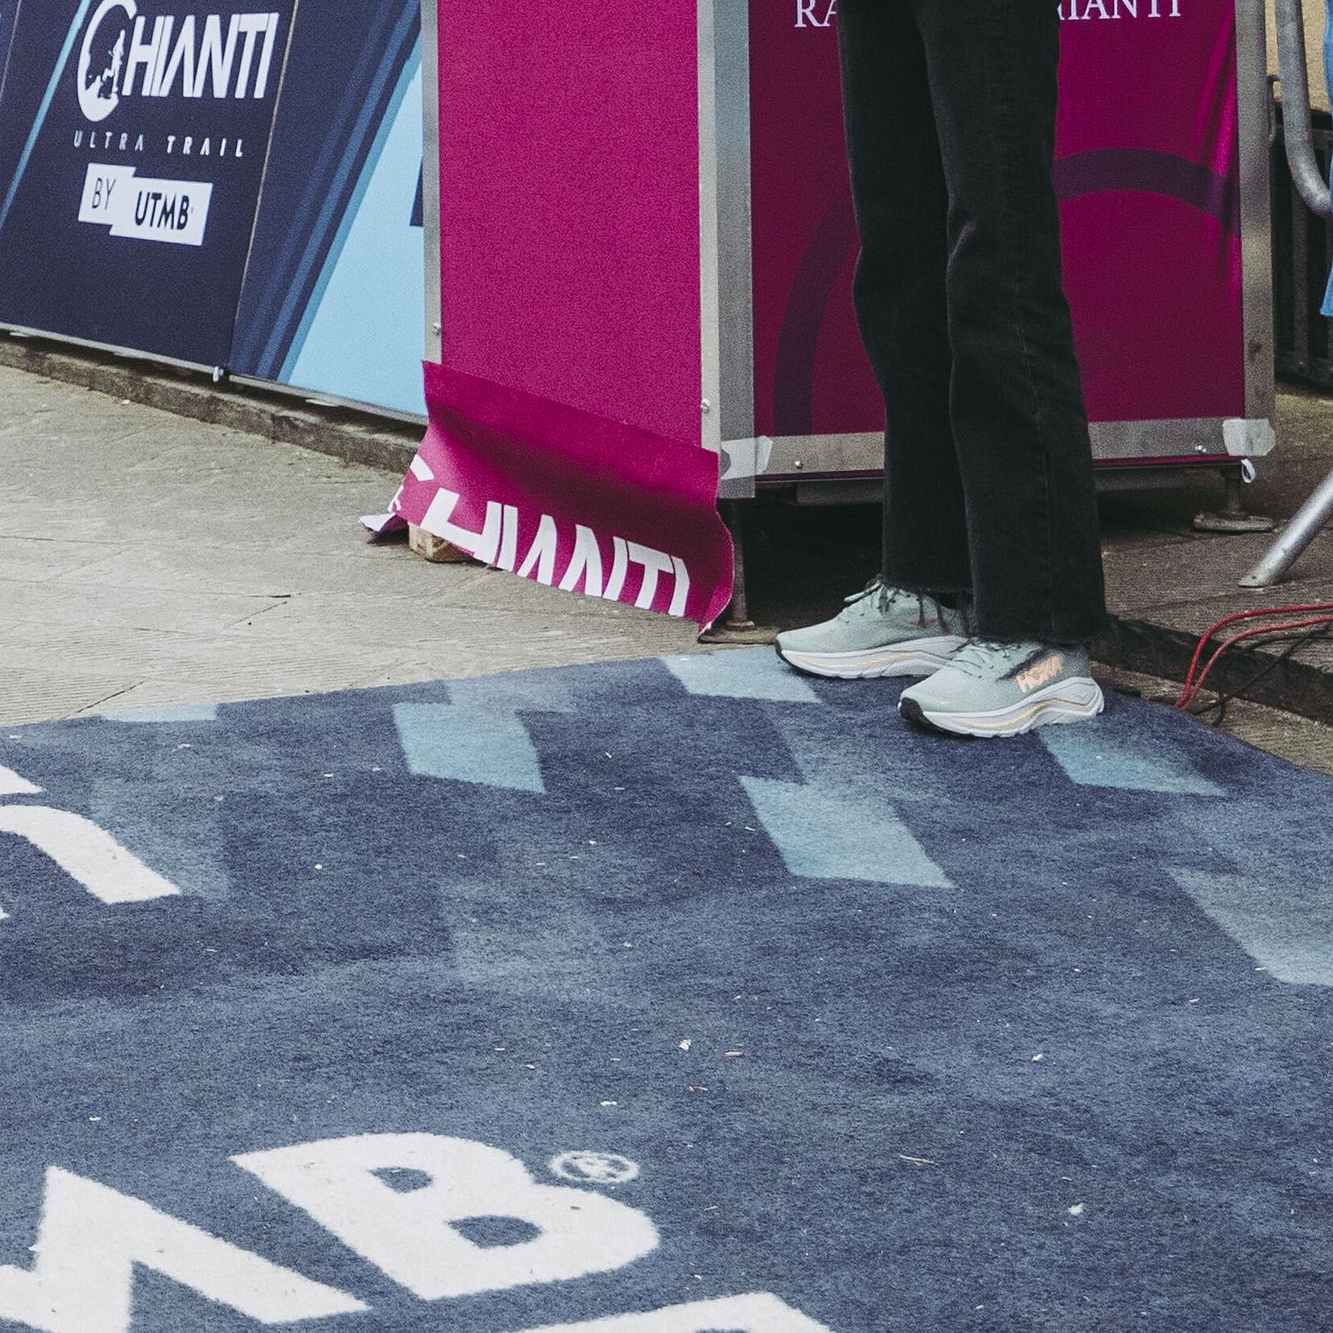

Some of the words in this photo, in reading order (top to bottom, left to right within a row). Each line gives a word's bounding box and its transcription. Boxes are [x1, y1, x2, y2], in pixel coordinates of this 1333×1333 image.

[73, 130, 145, 151] ULTRA
[166, 135, 244, 158] TRAIL
[91, 177, 117, 210] BY
[134, 190, 190, 230] UTMB
